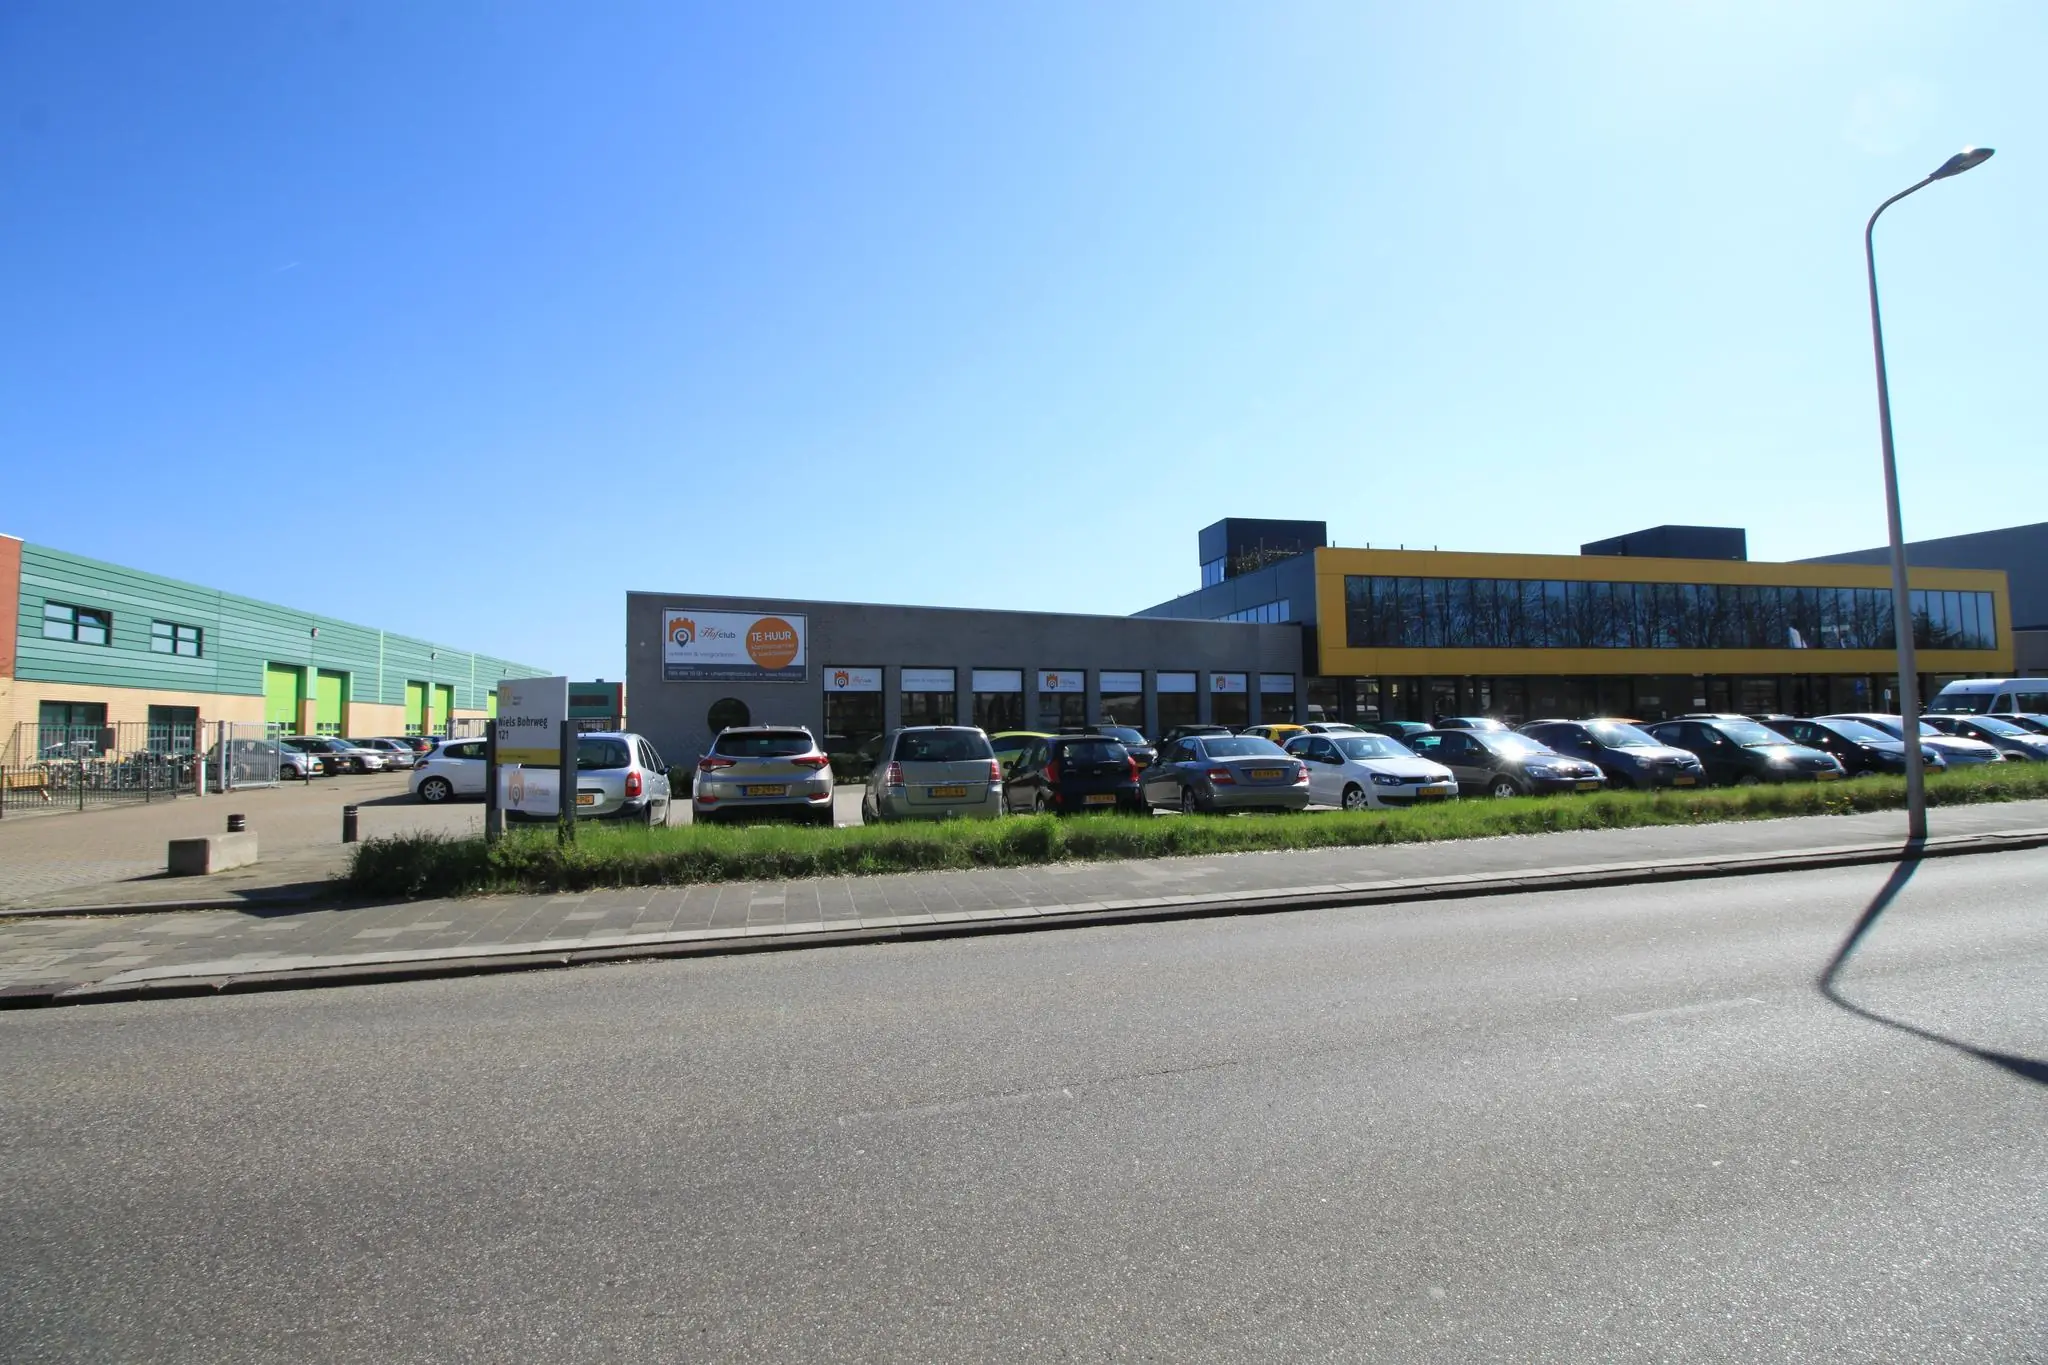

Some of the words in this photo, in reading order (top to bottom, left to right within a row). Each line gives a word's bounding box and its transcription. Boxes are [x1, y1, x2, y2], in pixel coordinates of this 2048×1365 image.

[752, 632, 762, 642] TE
[764, 631, 792, 641] HUUR
[498, 716, 516, 727] Niels
[517, 716, 548, 729] Bohrweg
[498, 730, 509, 740] 121
